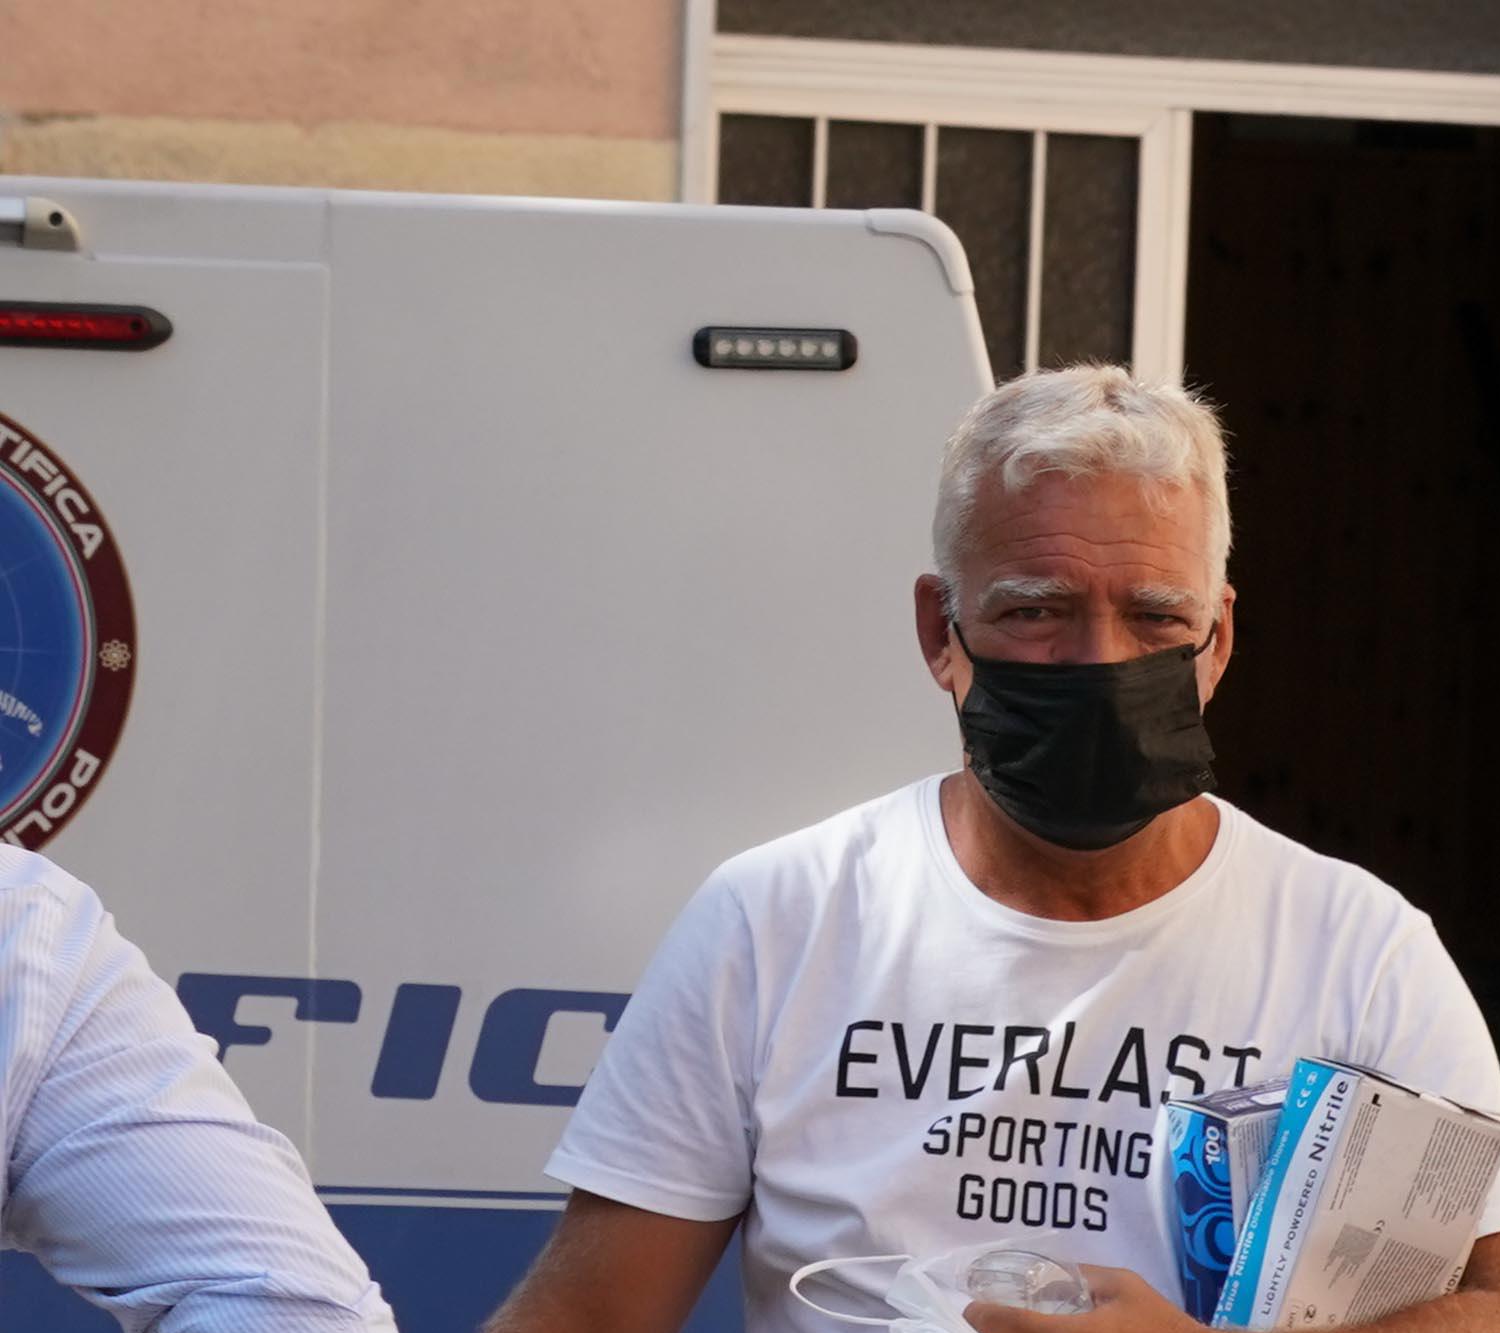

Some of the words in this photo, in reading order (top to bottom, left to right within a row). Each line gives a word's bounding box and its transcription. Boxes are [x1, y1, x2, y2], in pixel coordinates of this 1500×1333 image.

[835, 1020, 1262, 1109] EVERLAST
[922, 1112, 1154, 1180] SPORTING
[1204, 1125, 1220, 1166] 100
[956, 1173, 1109, 1233] GOODS
[1261, 1255, 1290, 1317] LIGHTLY
[1282, 1168, 1319, 1251] POWDERED
[1308, 1080, 1349, 1163] Nitrile
